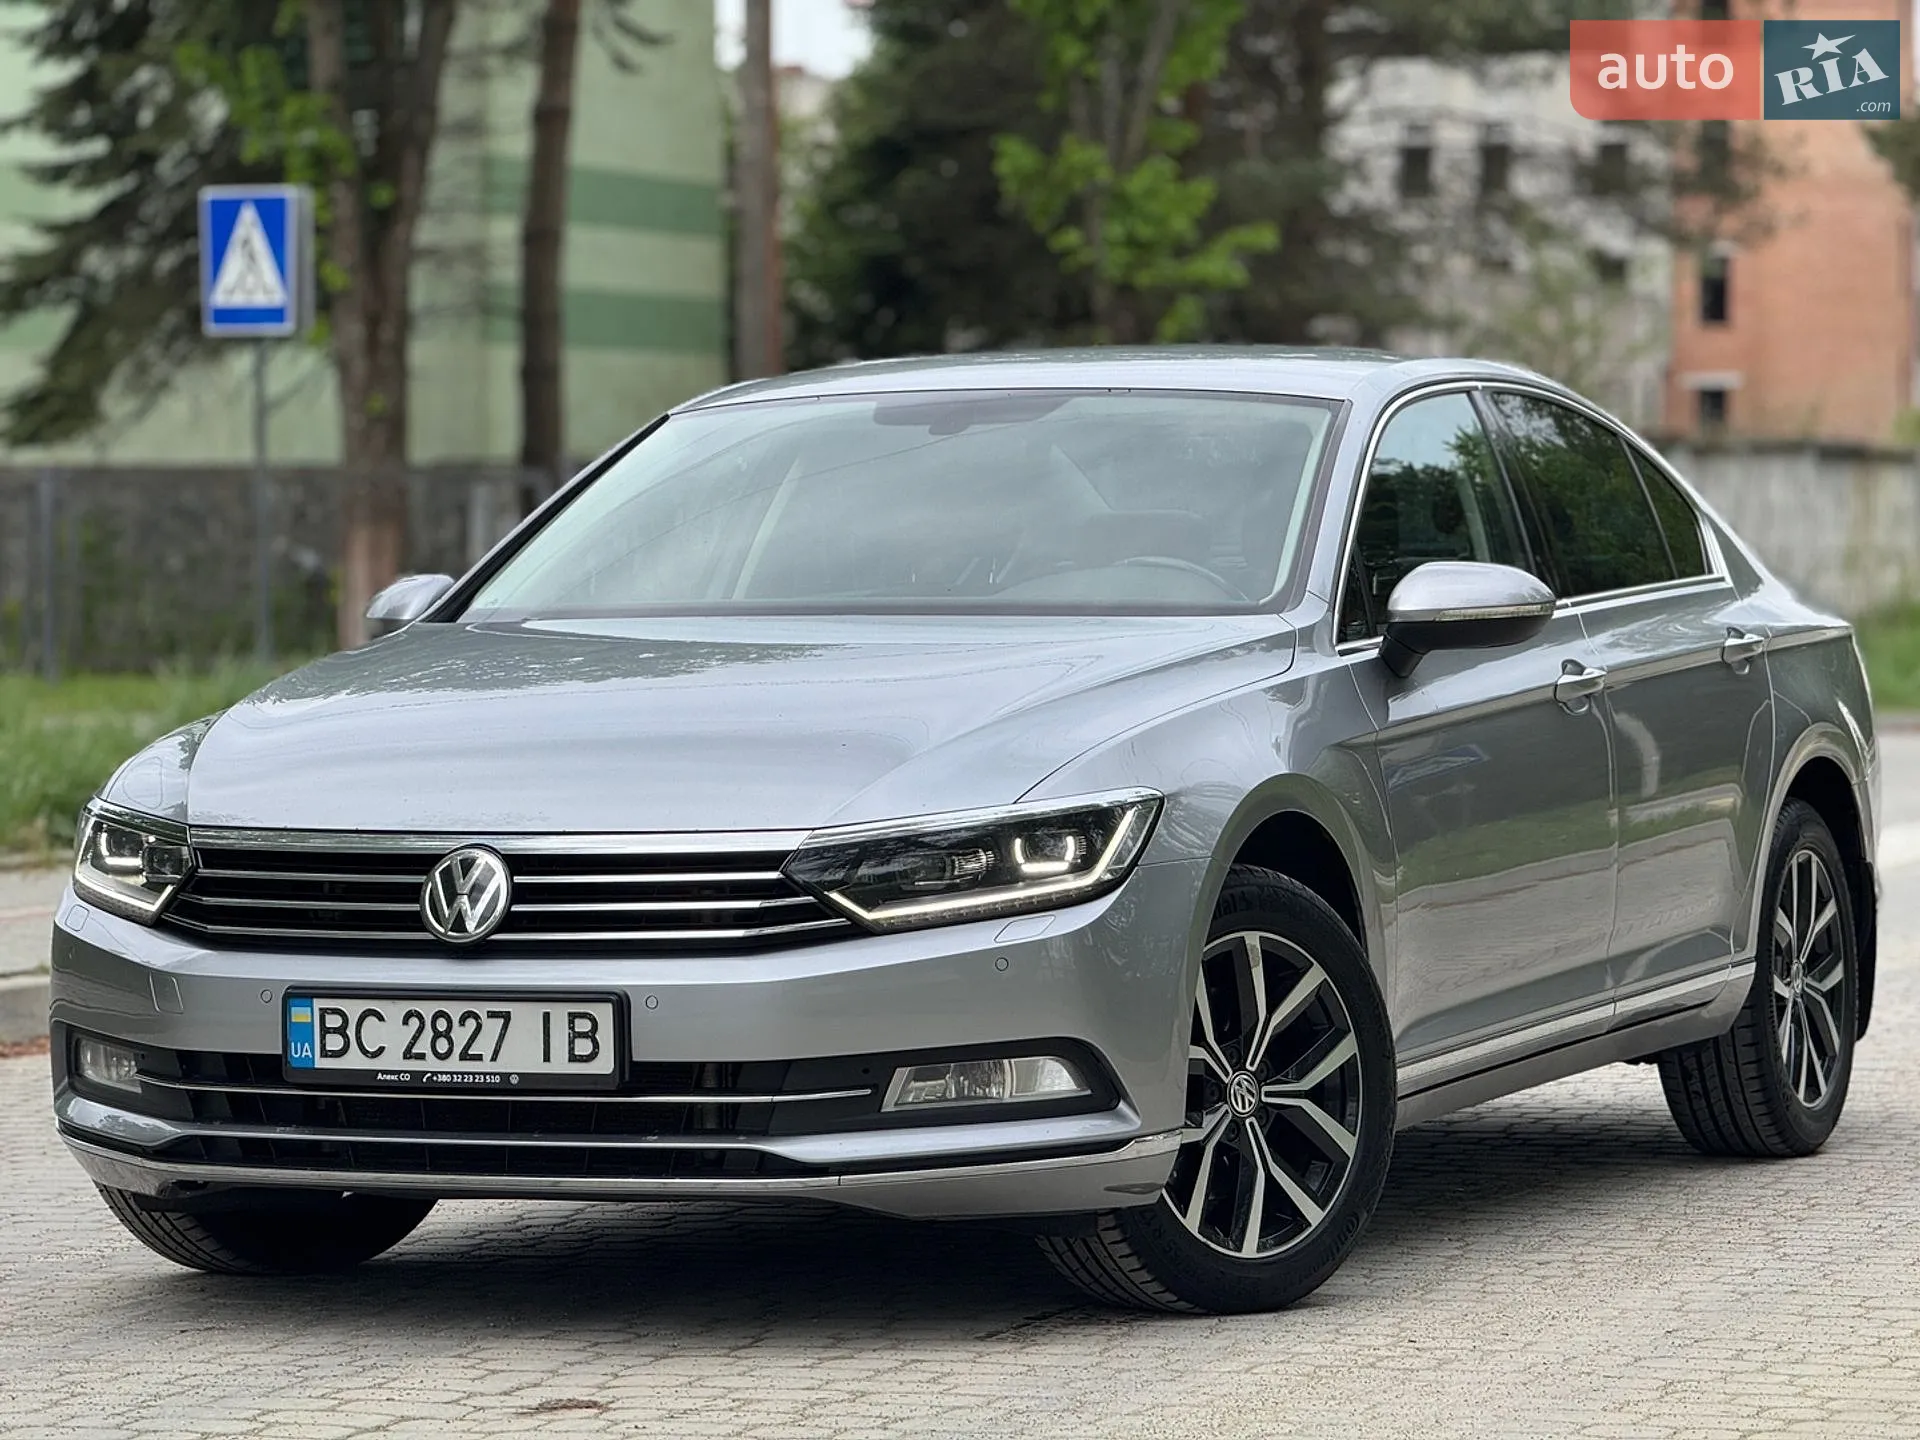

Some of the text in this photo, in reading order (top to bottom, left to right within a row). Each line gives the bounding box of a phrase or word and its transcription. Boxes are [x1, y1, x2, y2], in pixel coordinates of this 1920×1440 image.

[291, 1042, 313, 1059] UA
[318, 1007, 600, 1063] BC 2827 IB
